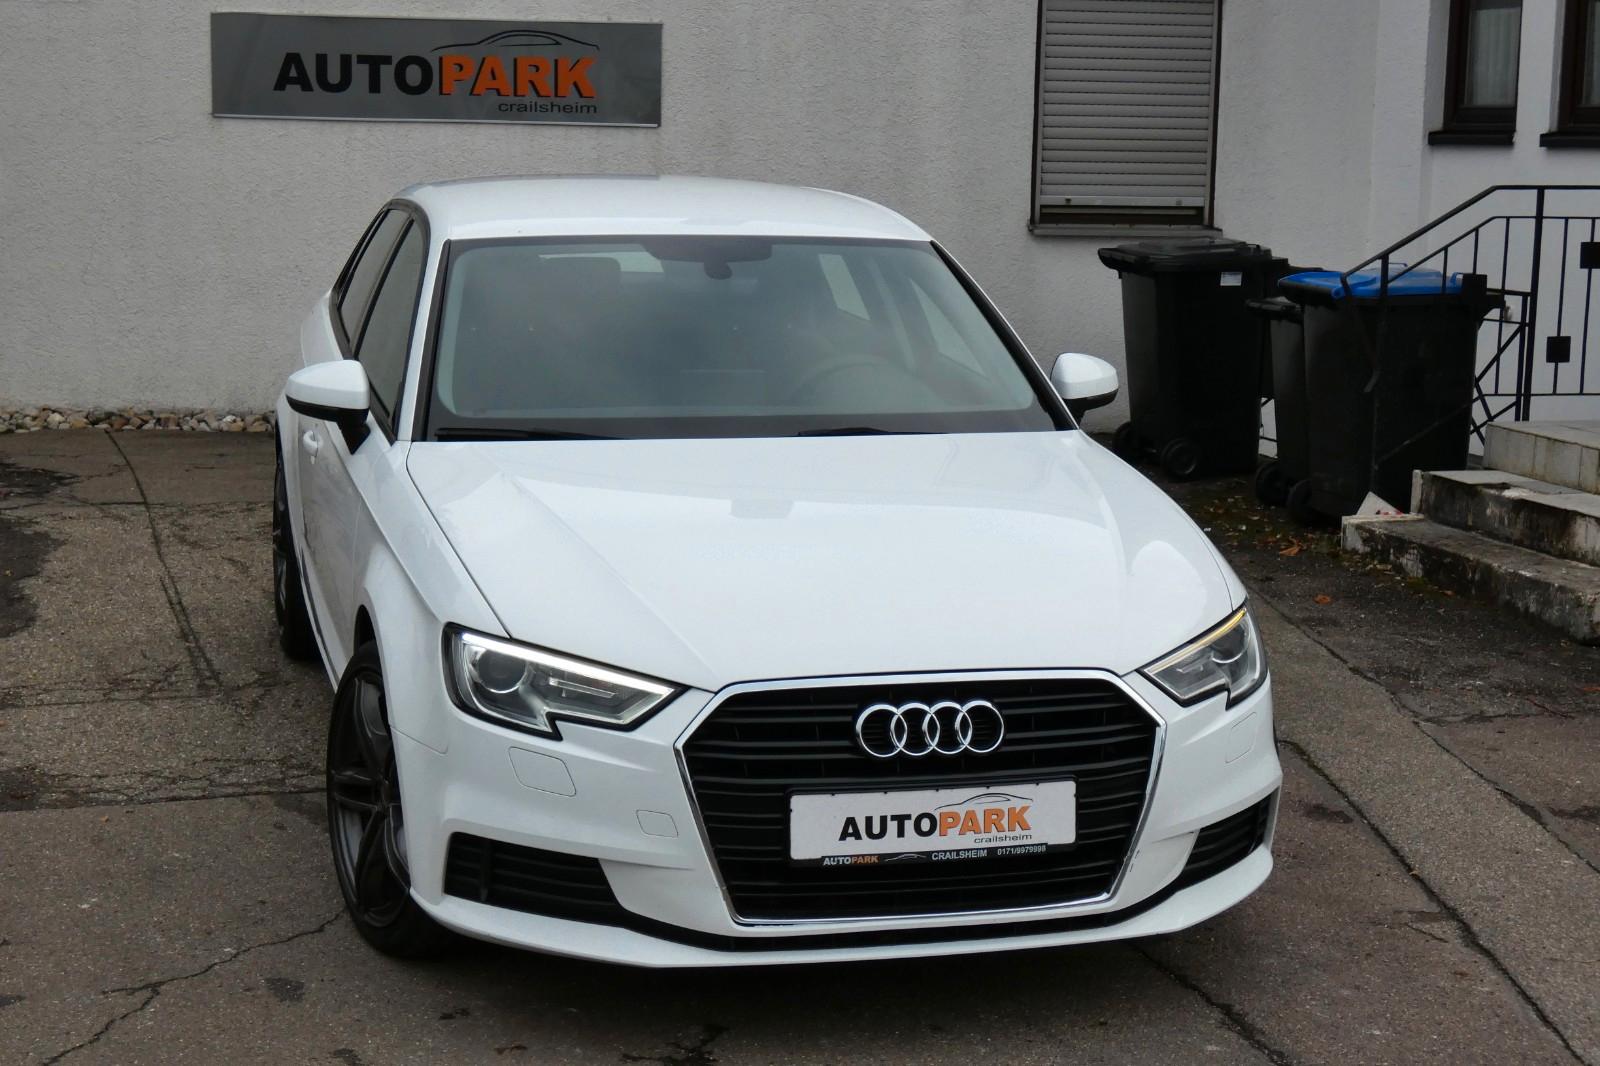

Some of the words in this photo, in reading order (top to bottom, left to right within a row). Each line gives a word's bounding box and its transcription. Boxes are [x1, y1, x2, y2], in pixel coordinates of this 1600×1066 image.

[273, 52, 597, 98] AUTOPARK
[498, 100, 597, 114] crailsheim
[838, 805, 1032, 841] AUTOPARK
[974, 833, 1032, 844] crailsheim
[823, 855, 879, 866] AUTOPARK
[931, 849, 988, 861] CRAILSHEIM
